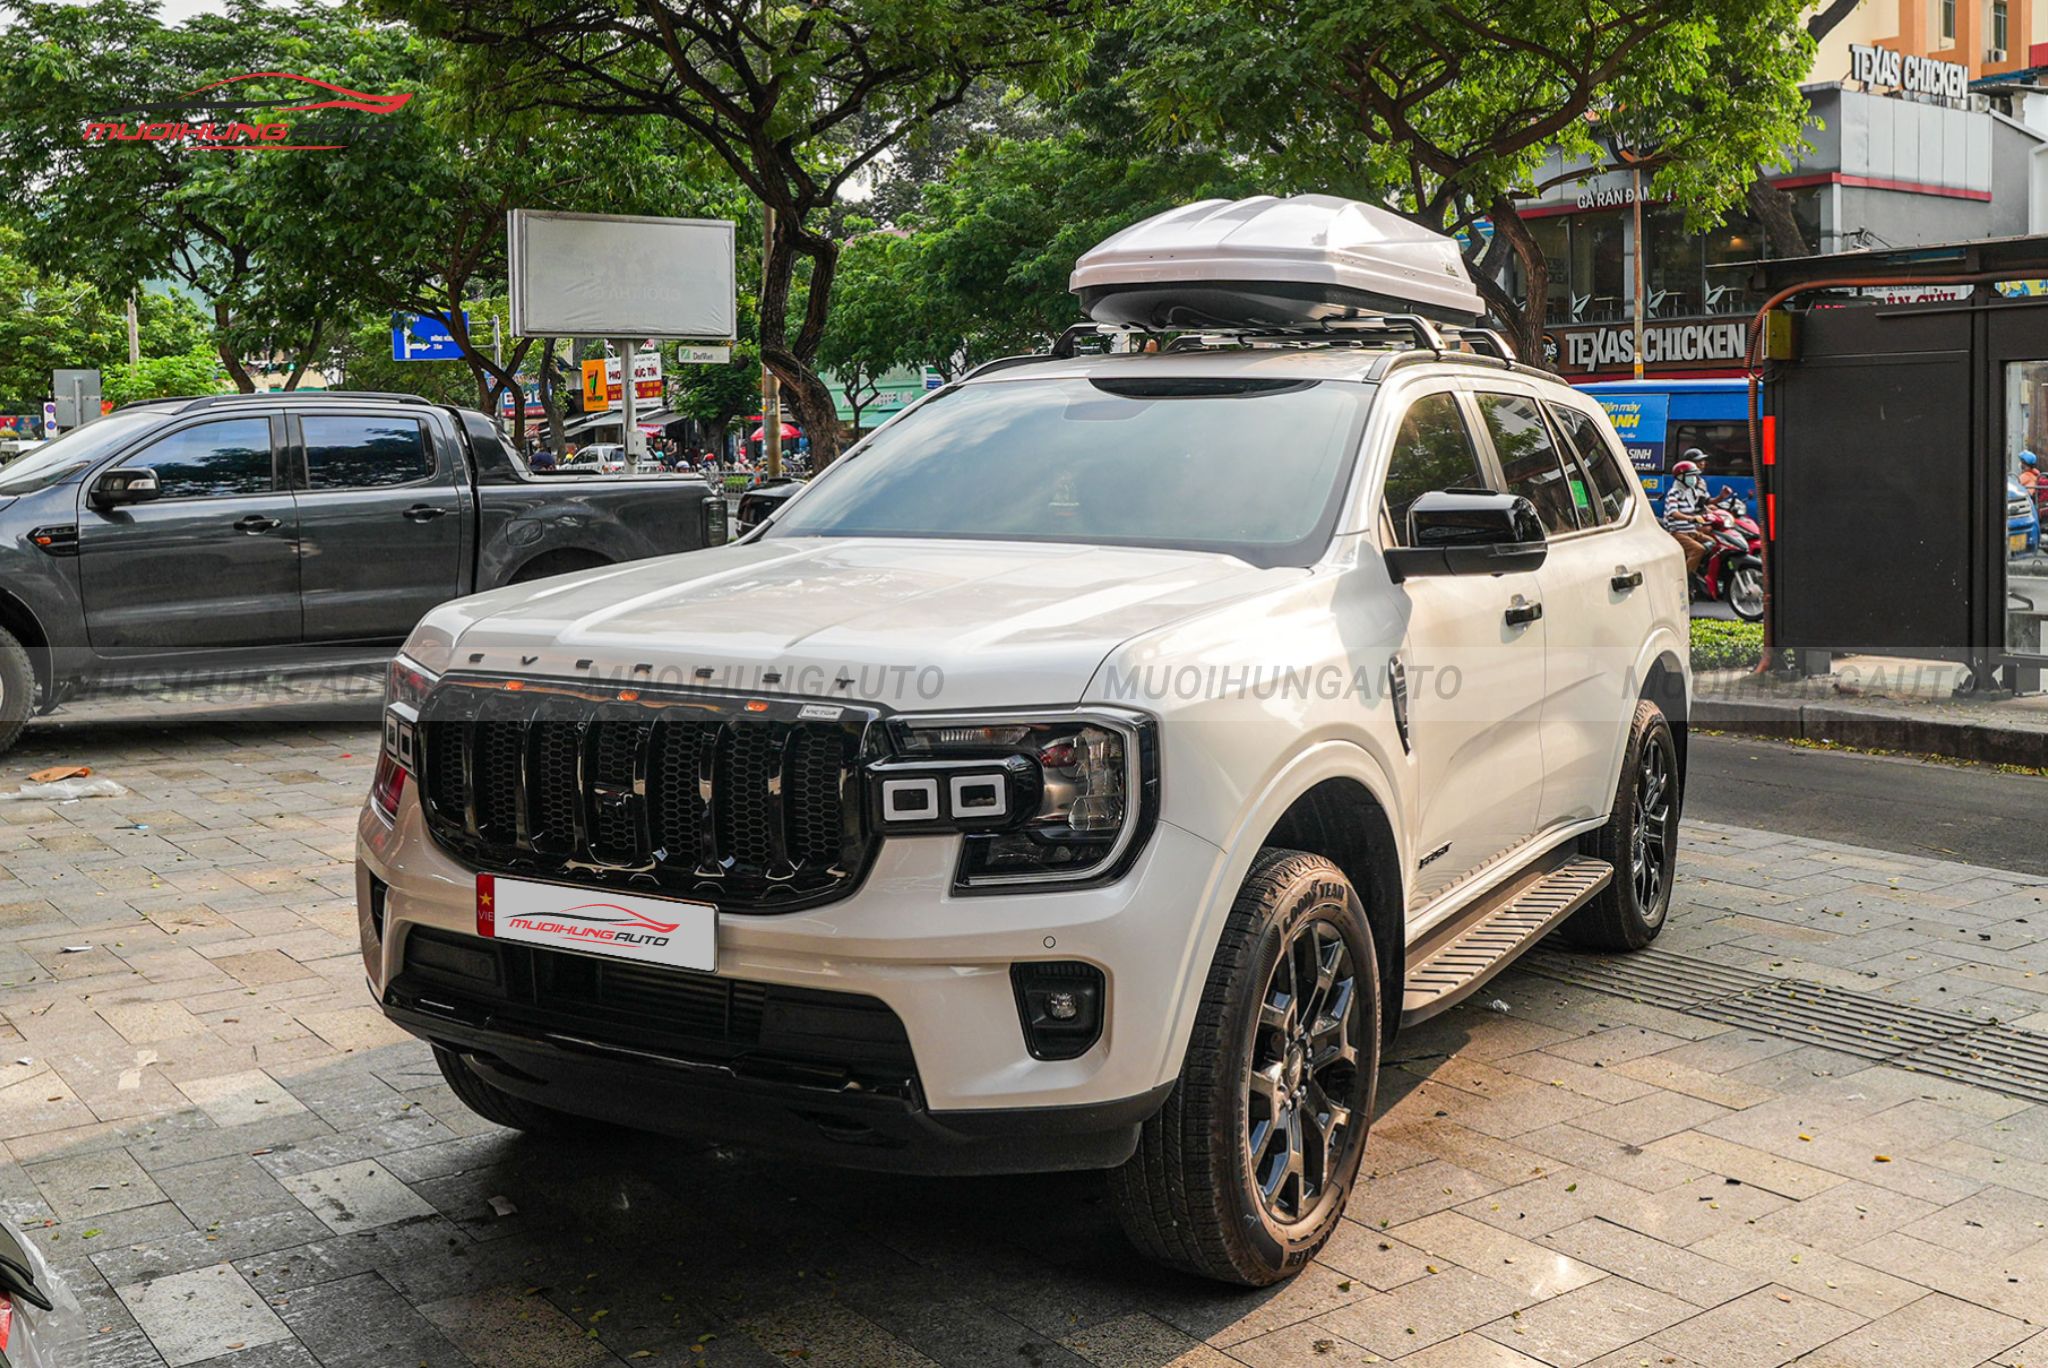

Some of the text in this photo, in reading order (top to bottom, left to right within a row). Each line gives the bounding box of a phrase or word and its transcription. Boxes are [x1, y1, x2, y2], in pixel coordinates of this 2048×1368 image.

[1850, 45, 1968, 99] TEXAS CHICKEN
[1597, 187, 1623, 207] RÁN
[1565, 323, 1746, 372] TEXAS CHICKEN
[1629, 448, 1652, 460] SINH
[469, 652, 854, 690] EVEREST
